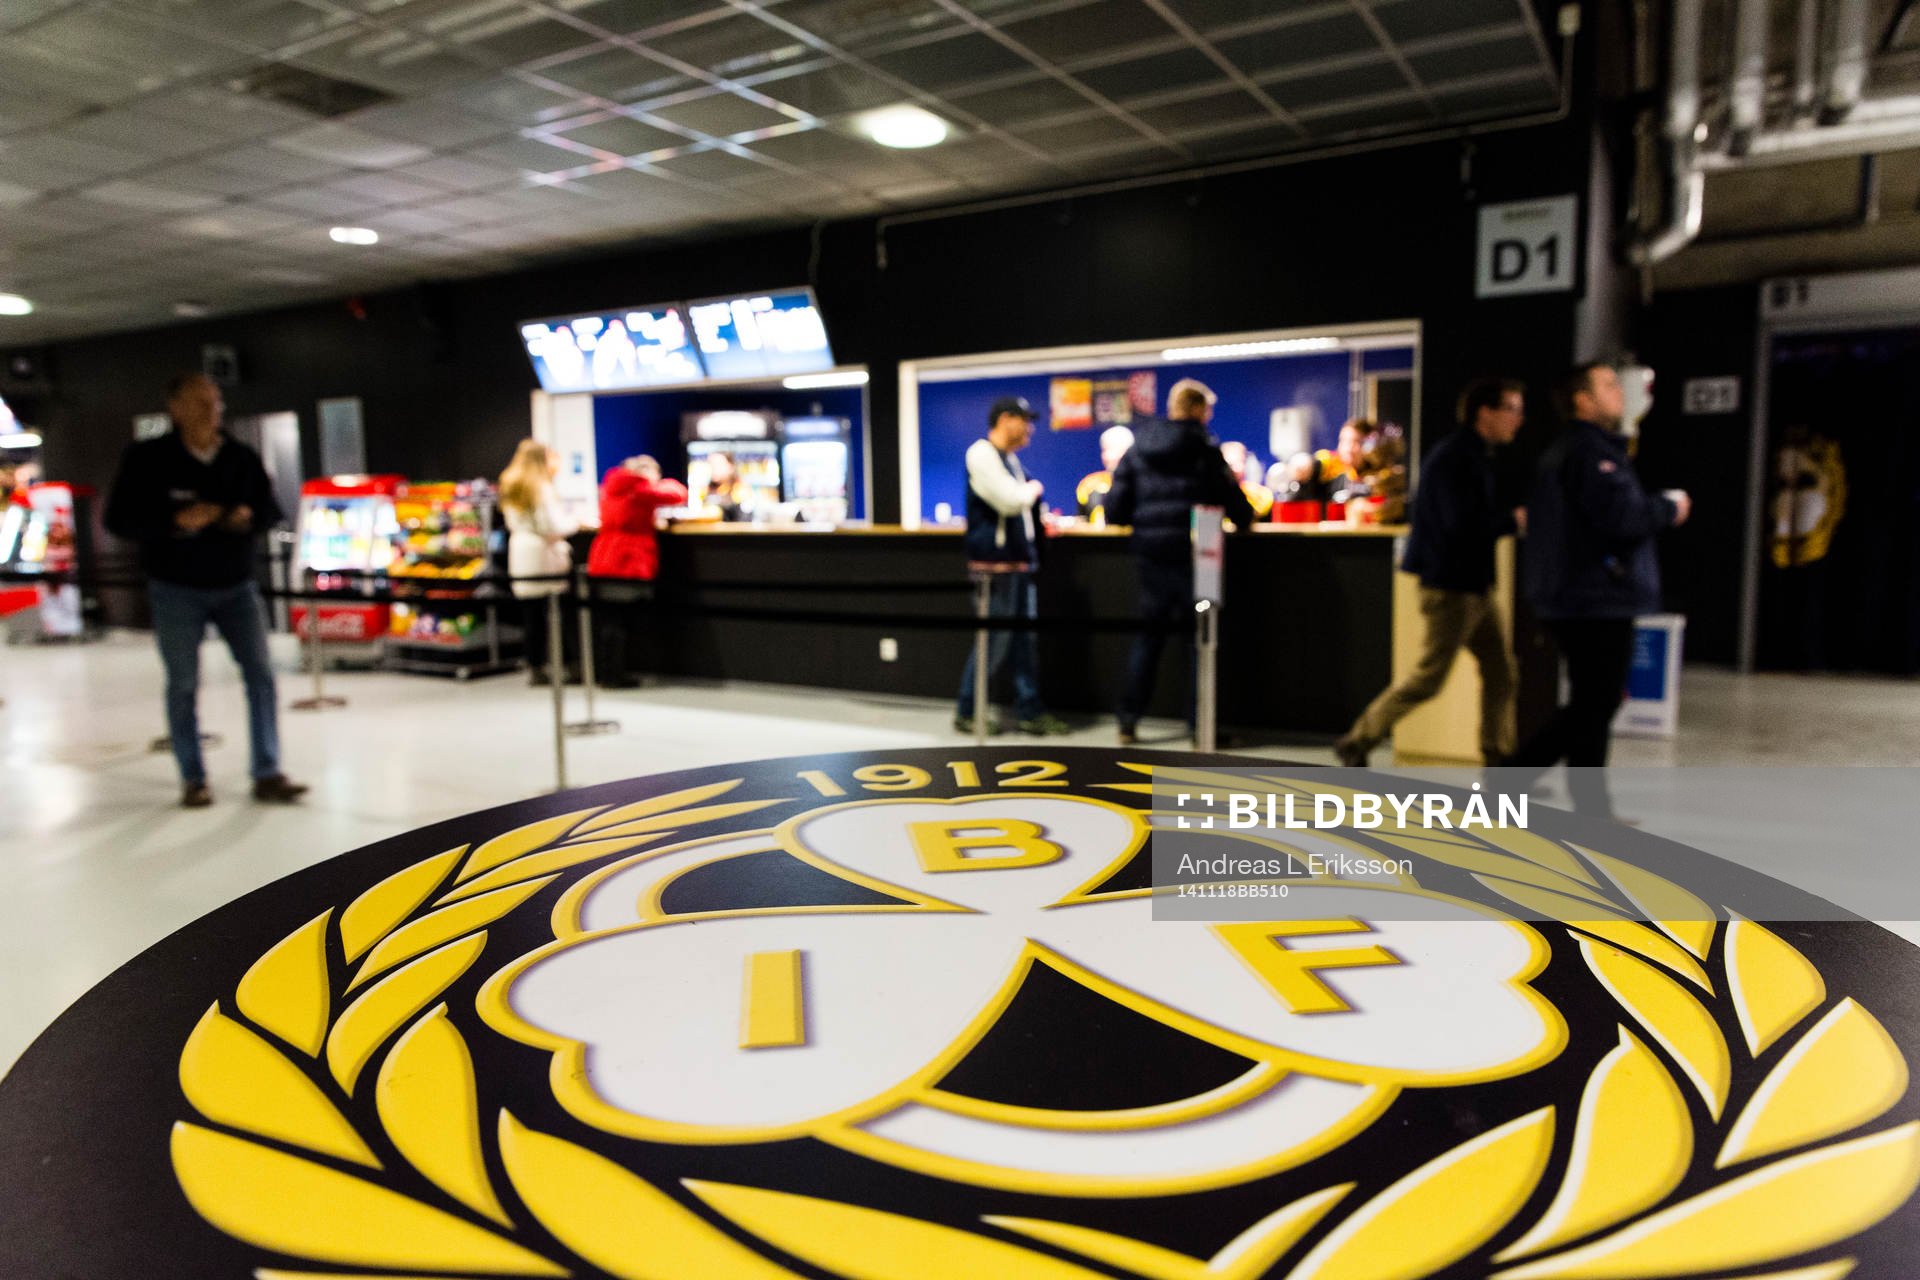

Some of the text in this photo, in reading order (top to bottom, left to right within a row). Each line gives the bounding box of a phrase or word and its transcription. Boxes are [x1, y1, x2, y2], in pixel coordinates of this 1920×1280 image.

[1491, 234, 1559, 282] D1
[797, 759, 1069, 798] 1912
[905, 819, 1064, 873] B
[1206, 915, 1401, 1014] F
[738, 949, 805, 1050] I
